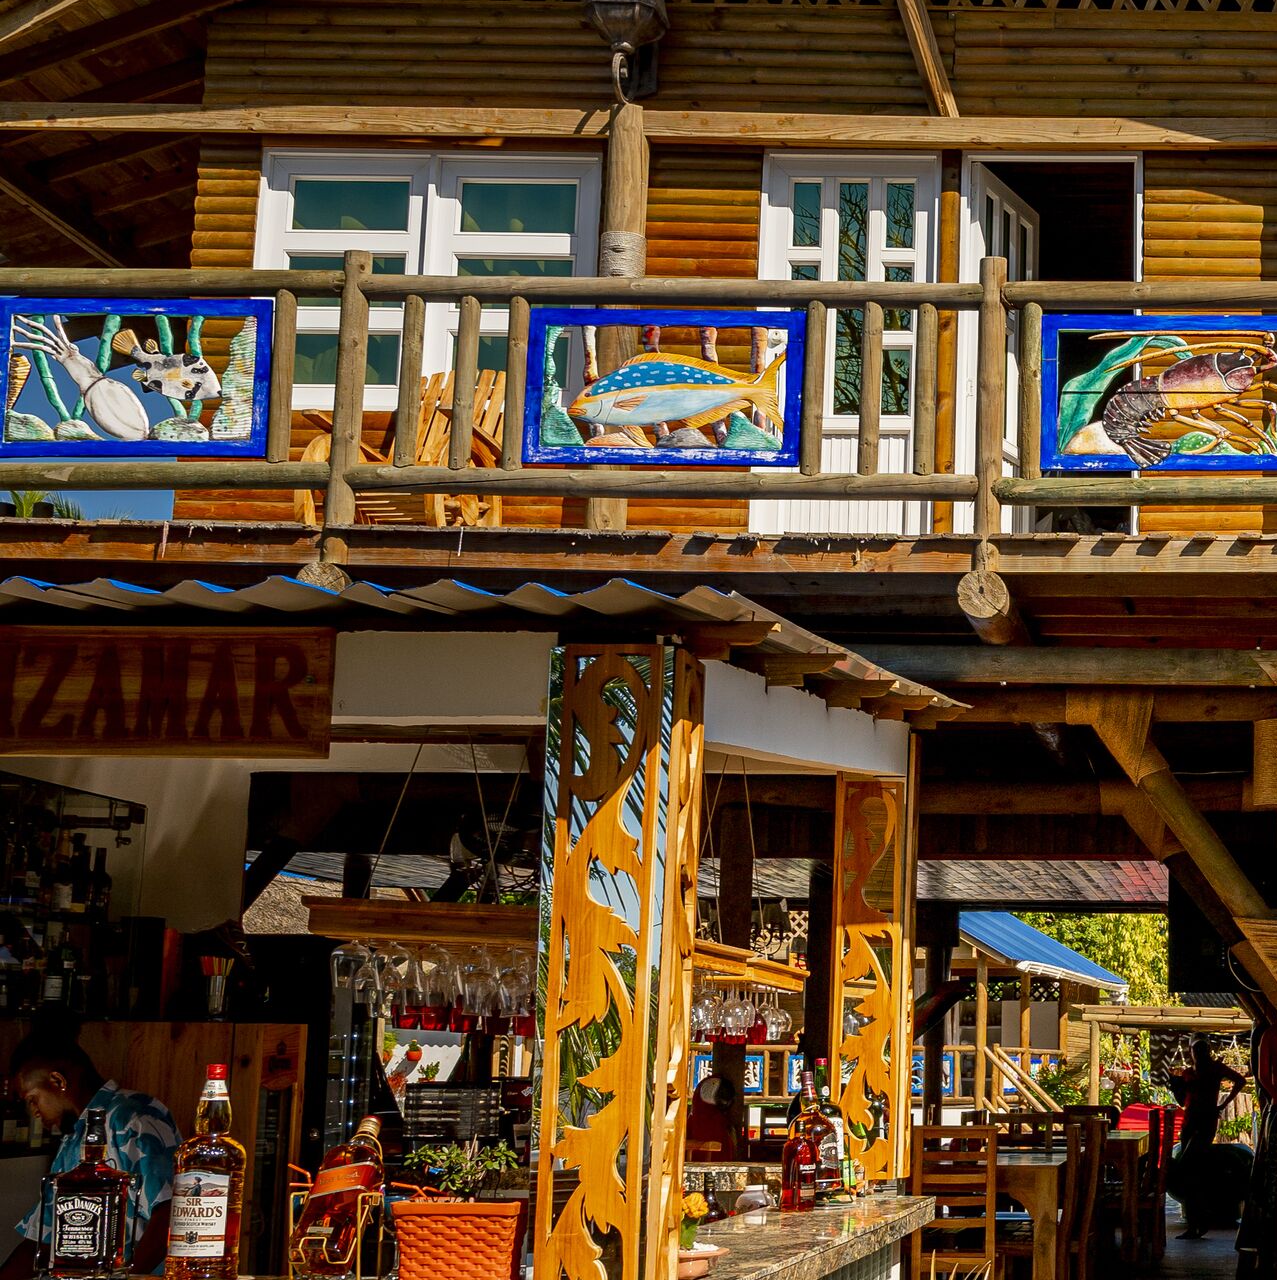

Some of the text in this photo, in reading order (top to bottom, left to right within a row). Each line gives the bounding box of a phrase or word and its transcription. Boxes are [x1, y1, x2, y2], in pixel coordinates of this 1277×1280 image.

[186, 1197, 202, 1206] SIR
[56, 1200, 74, 1215] JACK
[172, 1206, 223, 1217] EDWARD'S
[62, 1224, 94, 1232] Tennessee
